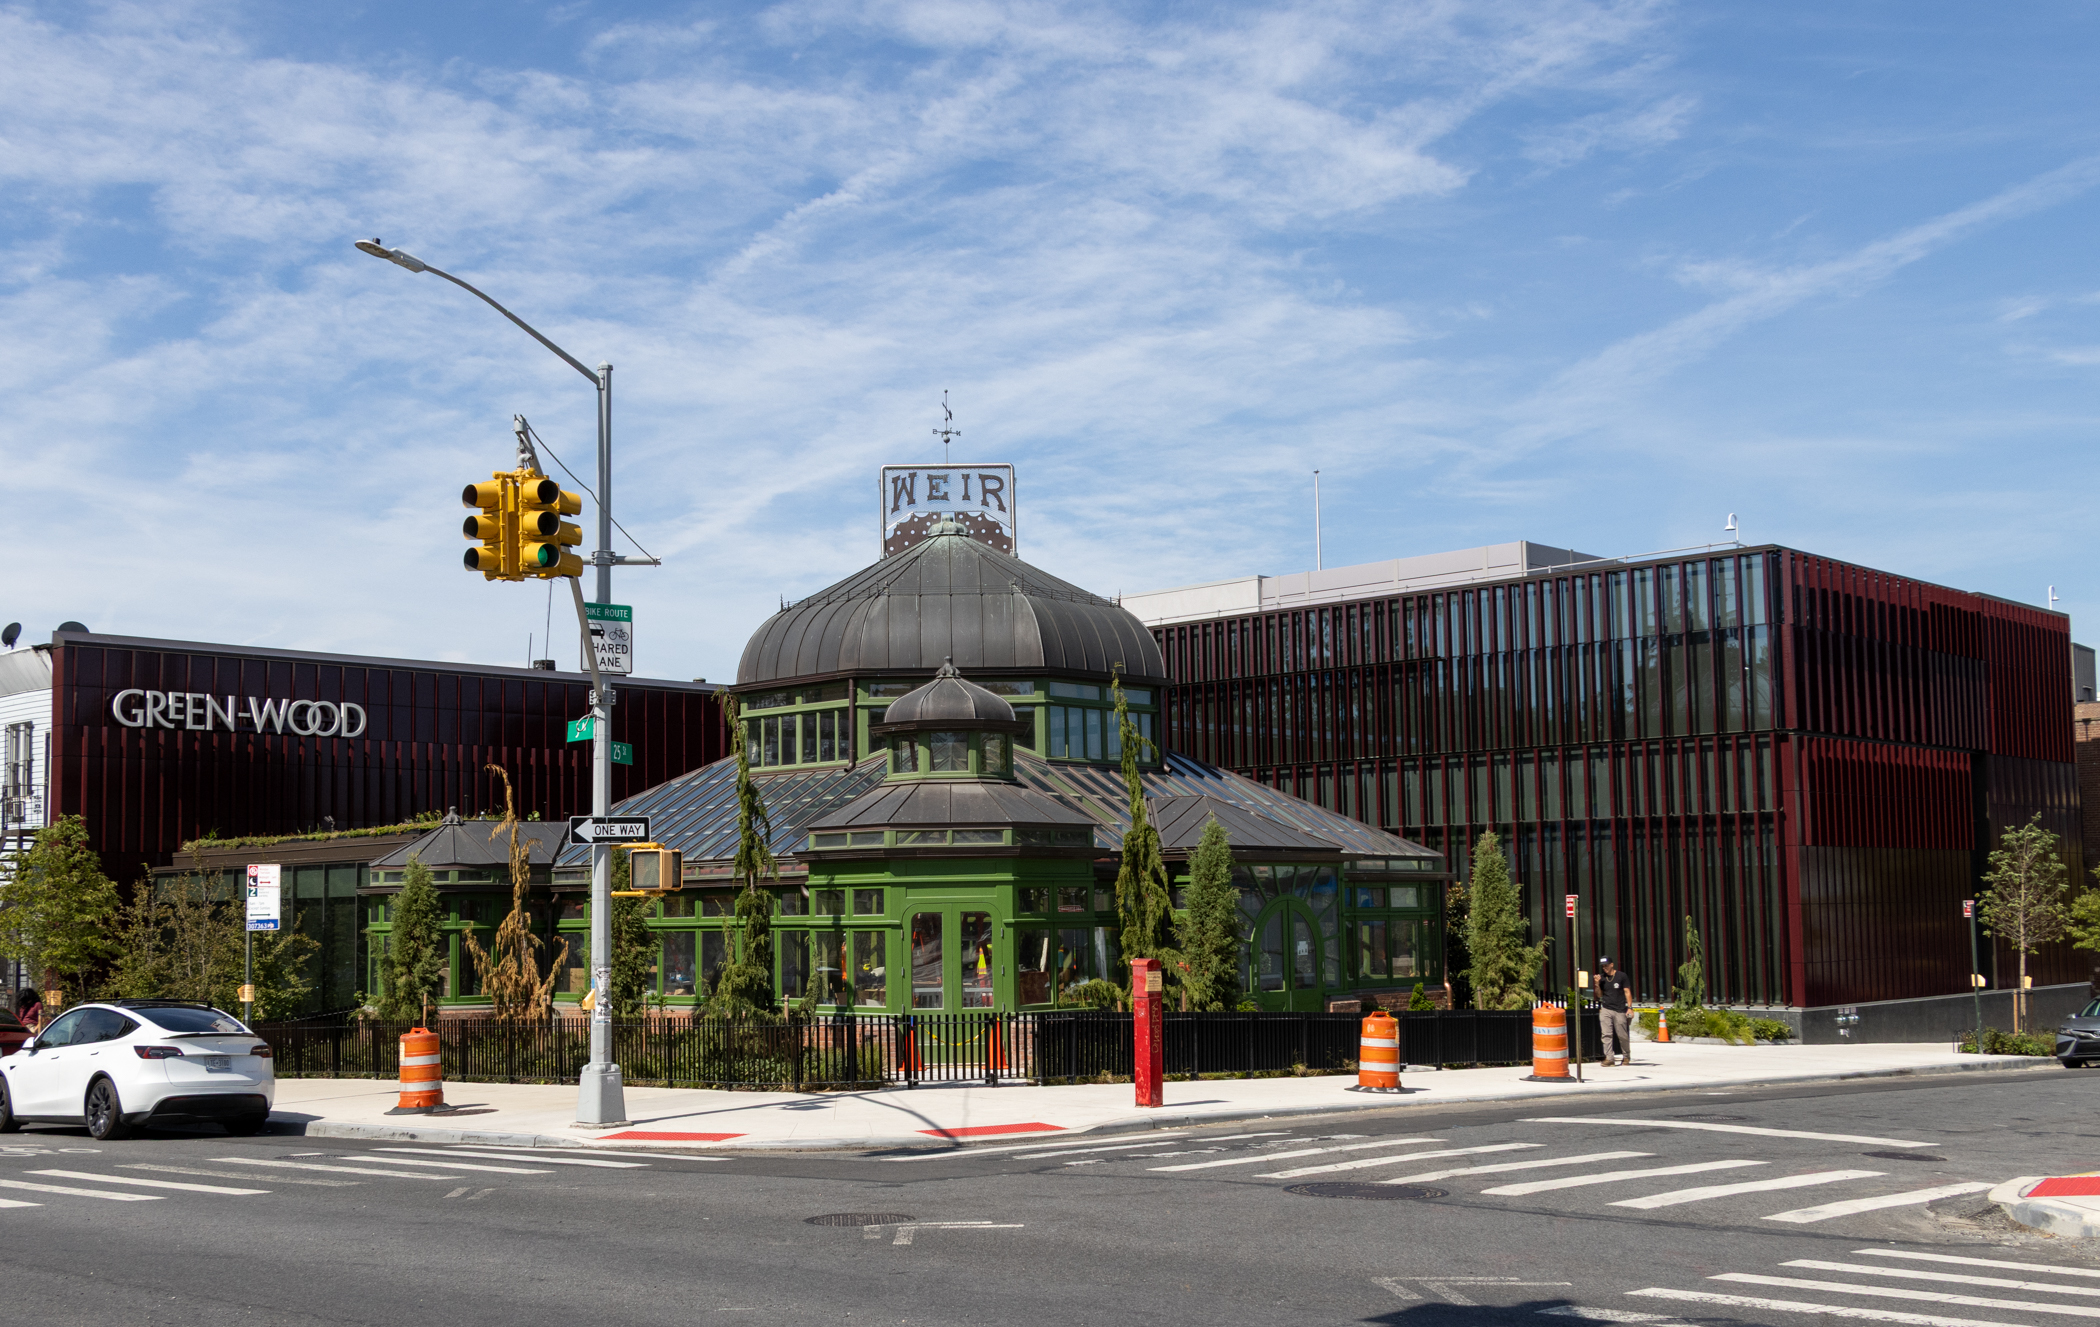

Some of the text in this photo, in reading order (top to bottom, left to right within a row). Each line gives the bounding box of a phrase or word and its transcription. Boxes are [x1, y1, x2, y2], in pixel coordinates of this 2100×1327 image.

[891, 471, 1007, 516] WEIR
[585, 607, 629, 618] BIKE ROUTE
[593, 642, 629, 655] HARED
[599, 656, 621, 668] ANE
[112, 688, 367, 738] GREEN-WOOD
[613, 744, 621, 760] 25
[594, 824, 642, 836] ONE WAY
[249, 887, 256, 897] 2
